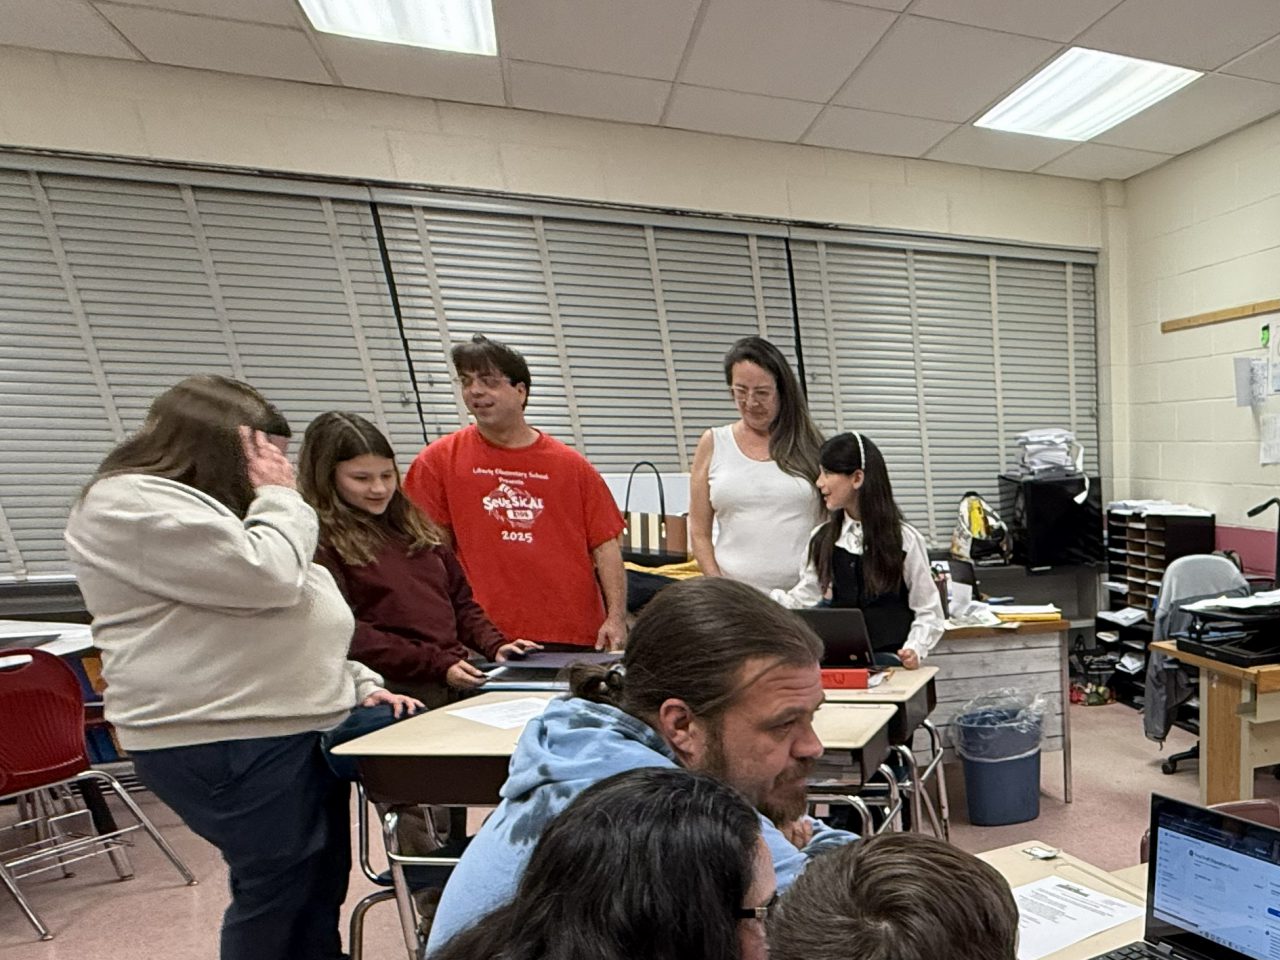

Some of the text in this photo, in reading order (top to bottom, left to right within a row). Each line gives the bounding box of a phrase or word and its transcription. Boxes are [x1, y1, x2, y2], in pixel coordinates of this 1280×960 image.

[472, 467, 549, 480] Liberty Elementary School
[501, 530, 533, 544] 2025
